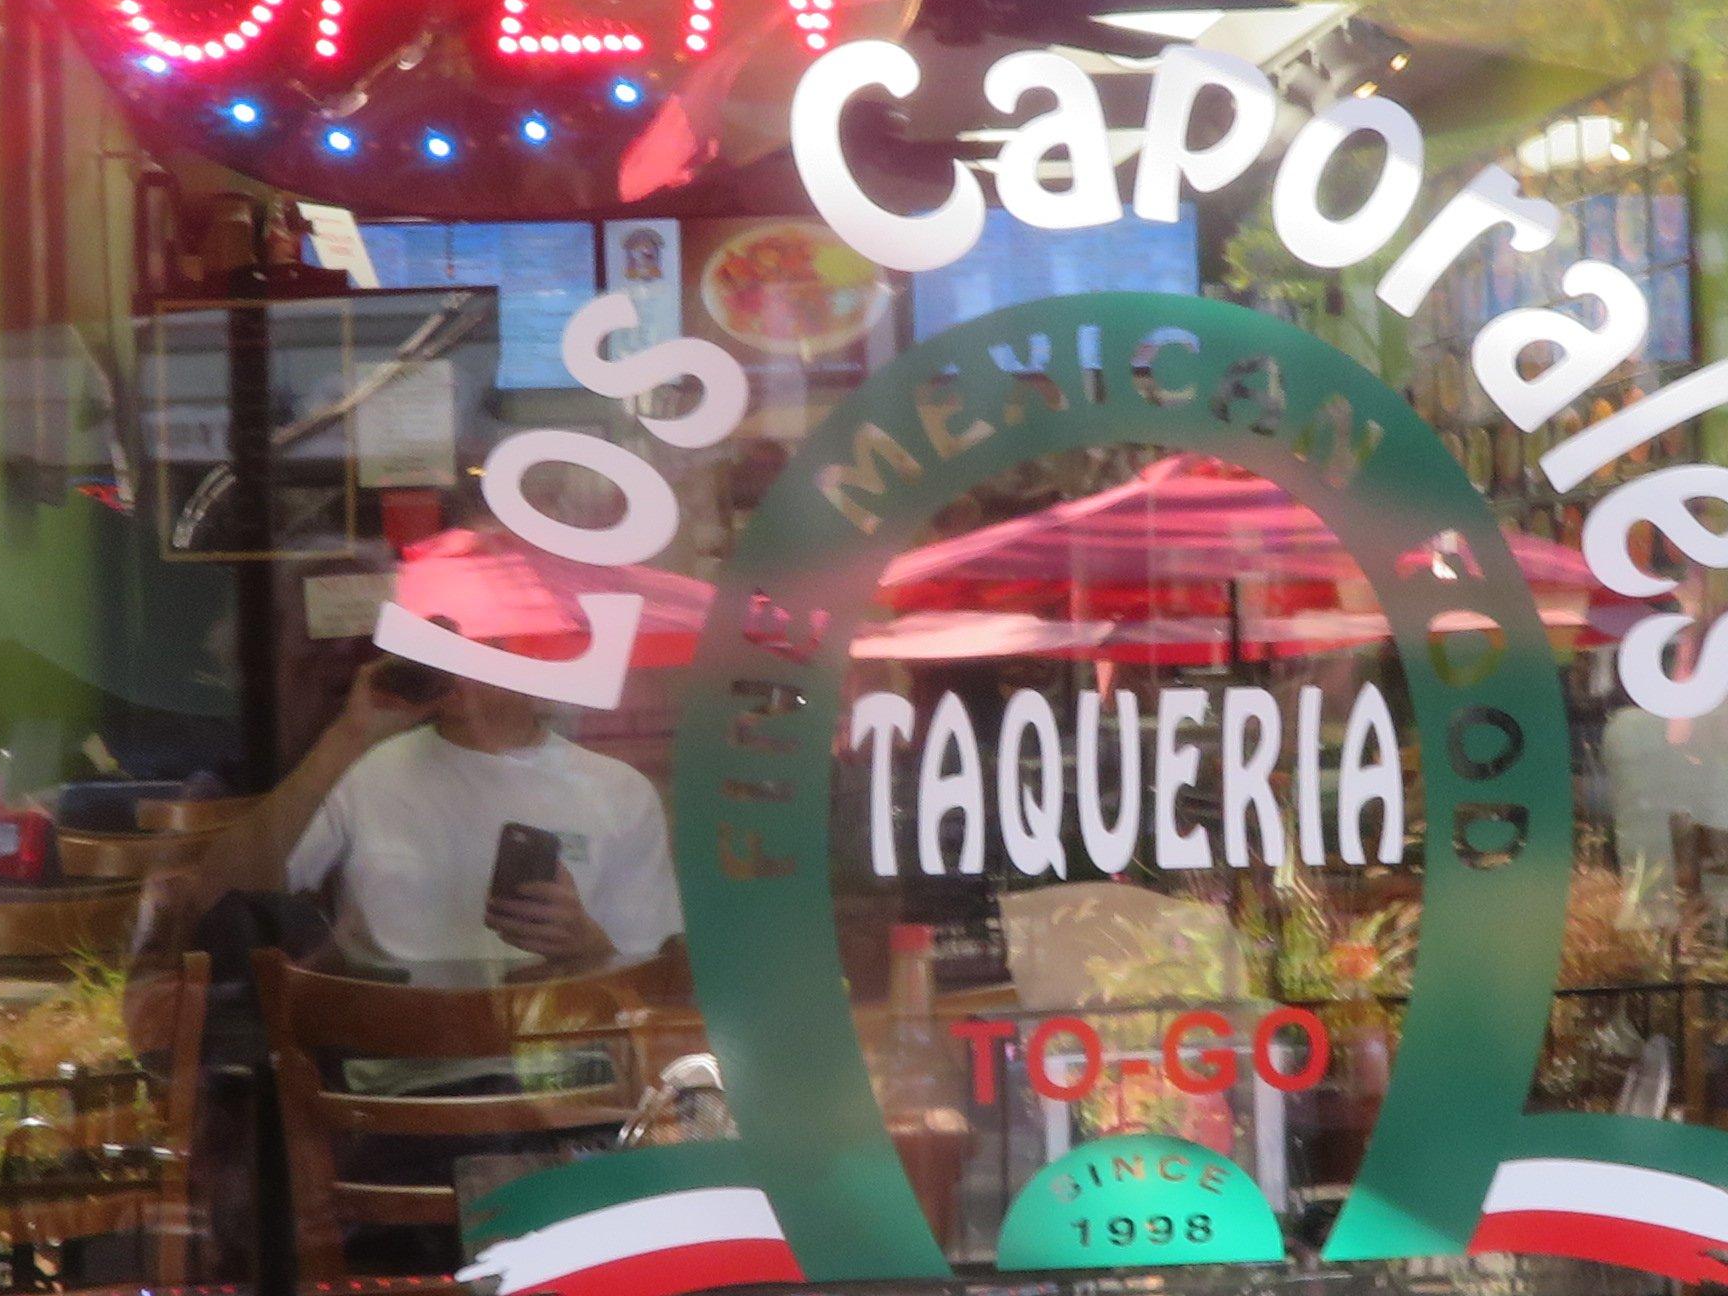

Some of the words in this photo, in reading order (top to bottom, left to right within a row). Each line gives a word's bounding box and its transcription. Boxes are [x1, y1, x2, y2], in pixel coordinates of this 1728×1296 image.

[374, 290, 750, 710] Los
[718, 588, 832, 882] FINE
[817, 322, 1384, 536] MEXICAN
[1394, 528, 1530, 872] FOOD
[850, 684, 1404, 878] TAQUERIA
[948, 1006, 1332, 1106] TO-GO
[1048, 1153, 1234, 1204] SINCE
[1070, 1212, 1215, 1250] 1998
